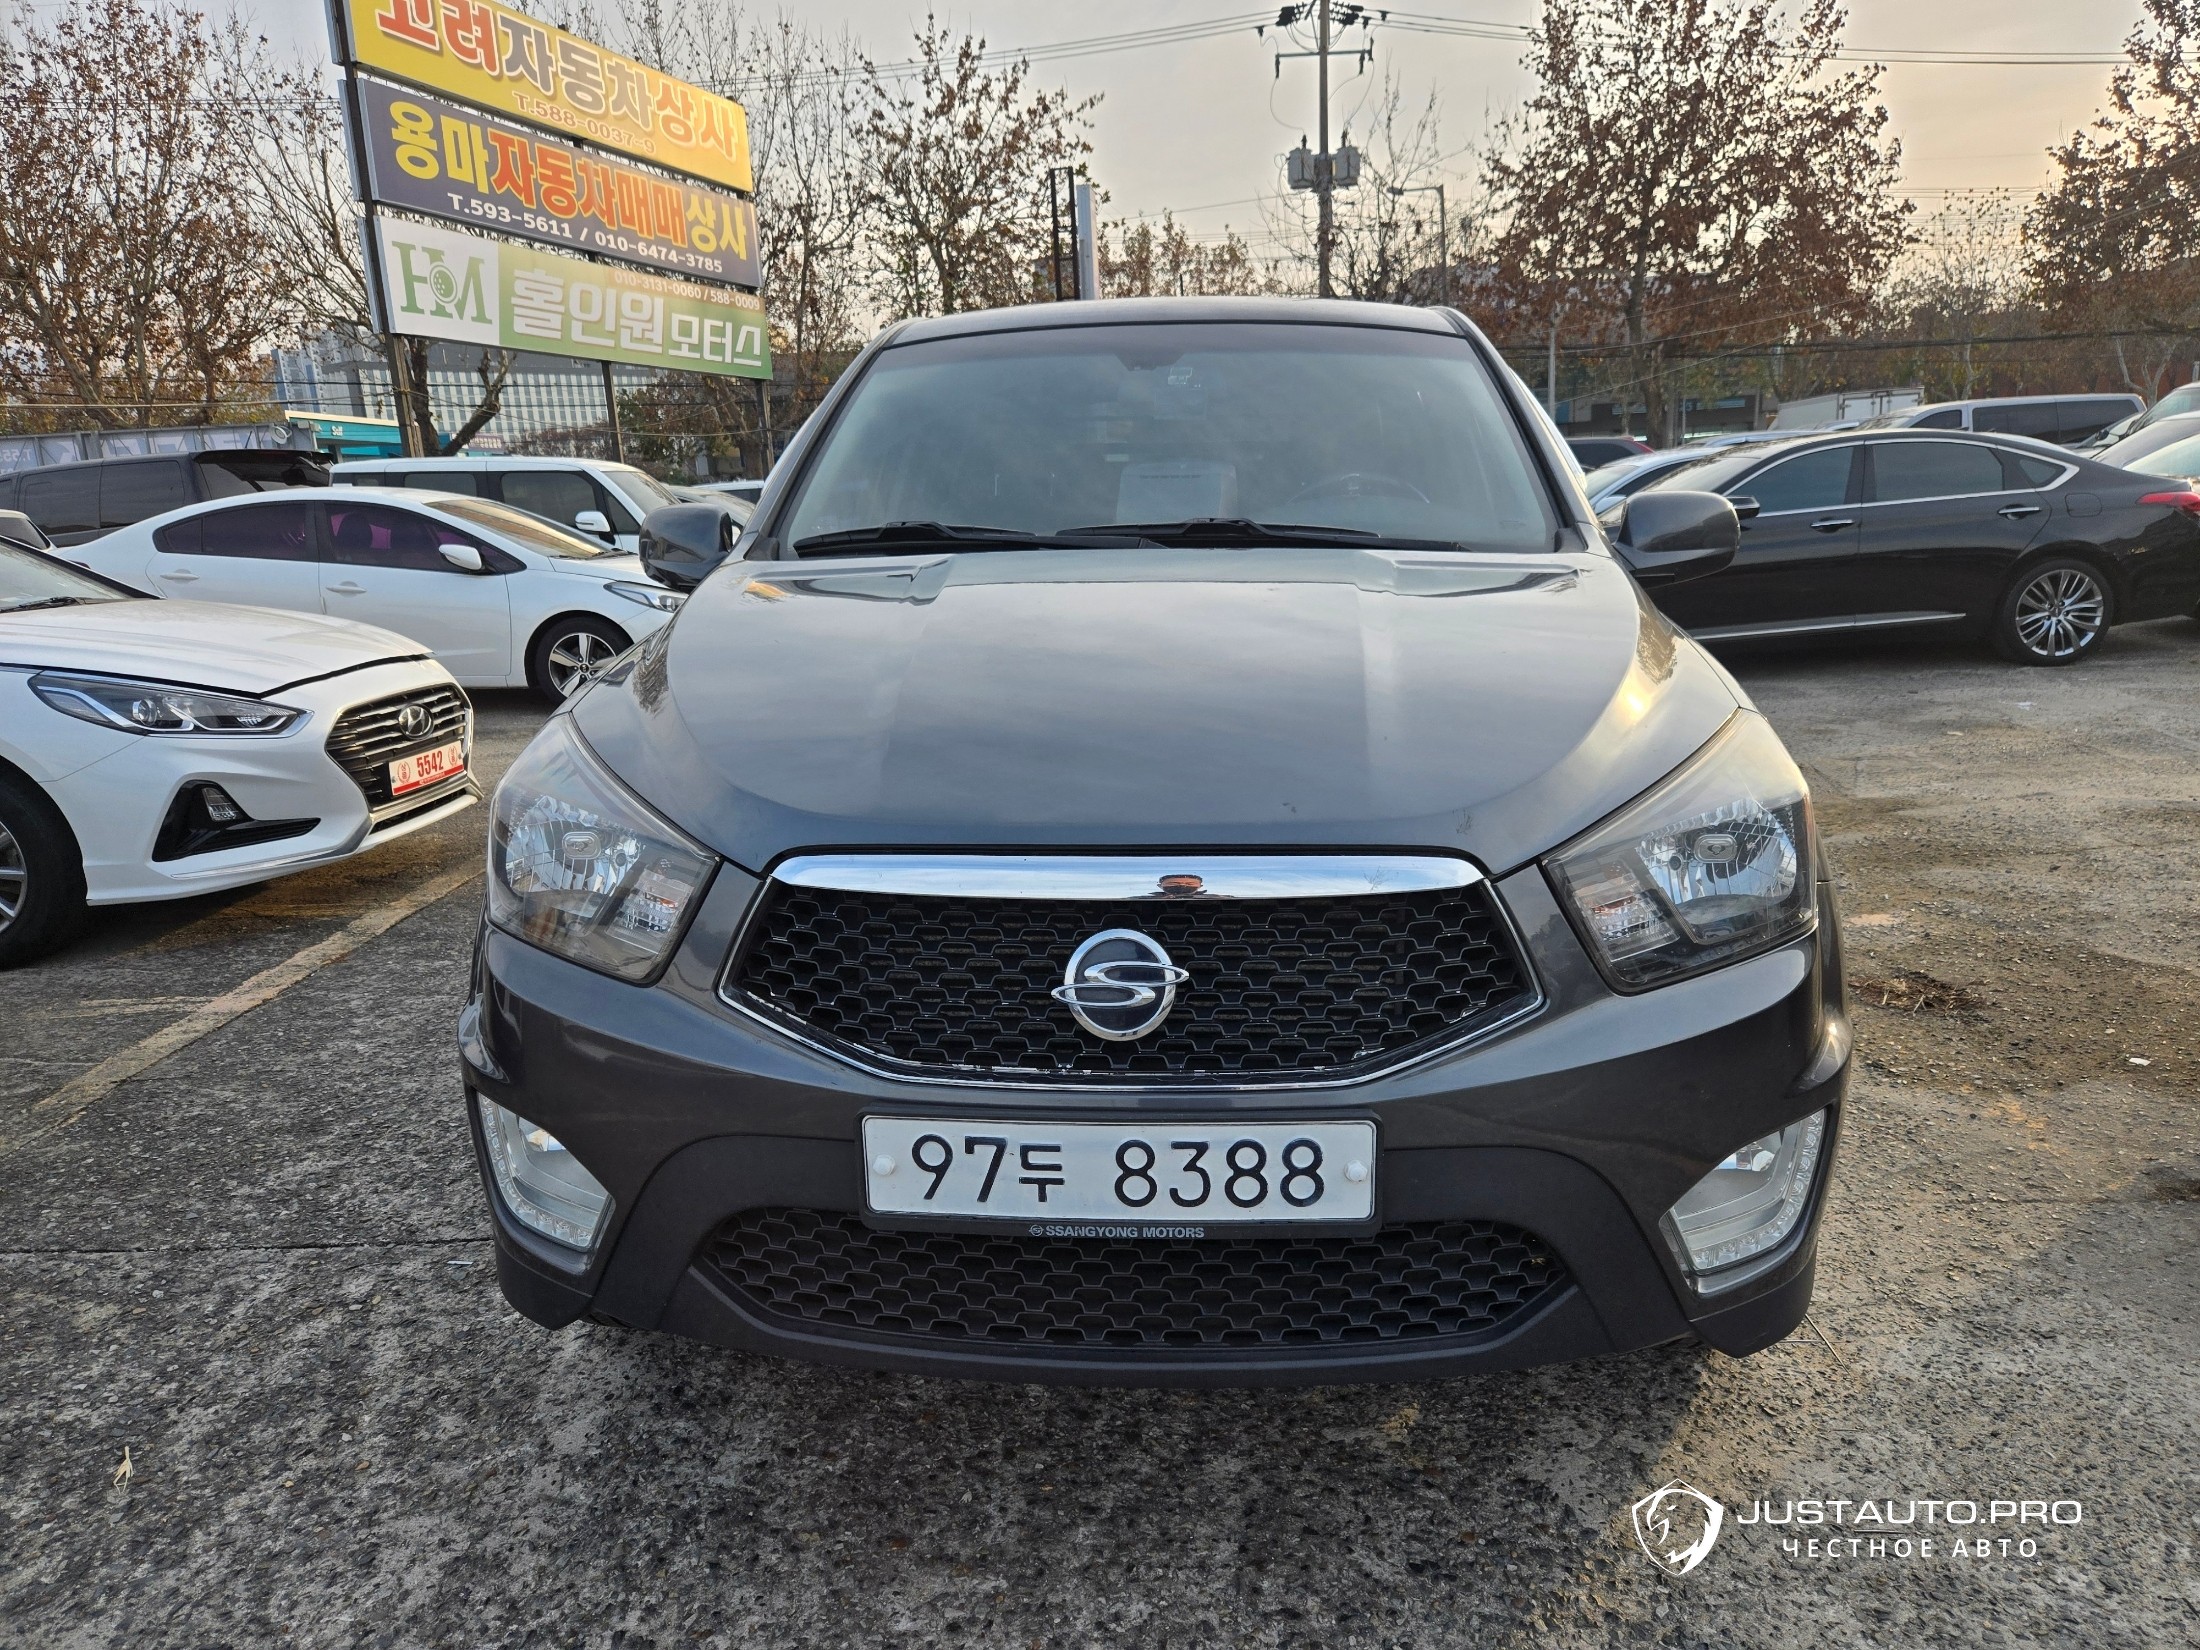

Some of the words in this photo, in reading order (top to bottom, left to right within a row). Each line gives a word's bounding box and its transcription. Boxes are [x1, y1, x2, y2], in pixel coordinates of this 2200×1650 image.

[512, 91, 655, 155] T.588-0037-9
[390, 101, 747, 260] 용마자동차매매상사
[448, 193, 573, 239] T.593-5611
[594, 231, 722, 273] 010-6474-3785
[512, 268, 664, 354] 홀인원
[669, 312, 761, 367] 모터스
[615, 271, 701, 299] 010-3131-0060
[709, 289, 760, 311] 588-0009
[416, 750, 444, 777] 5542
[911, 1134, 1065, 1203] 97두
[1114, 1138, 1325, 1208] 8388
[1046, 1225, 1138, 1239] SSANGYONG
[1142, 1226, 1205, 1239] MOTORS
